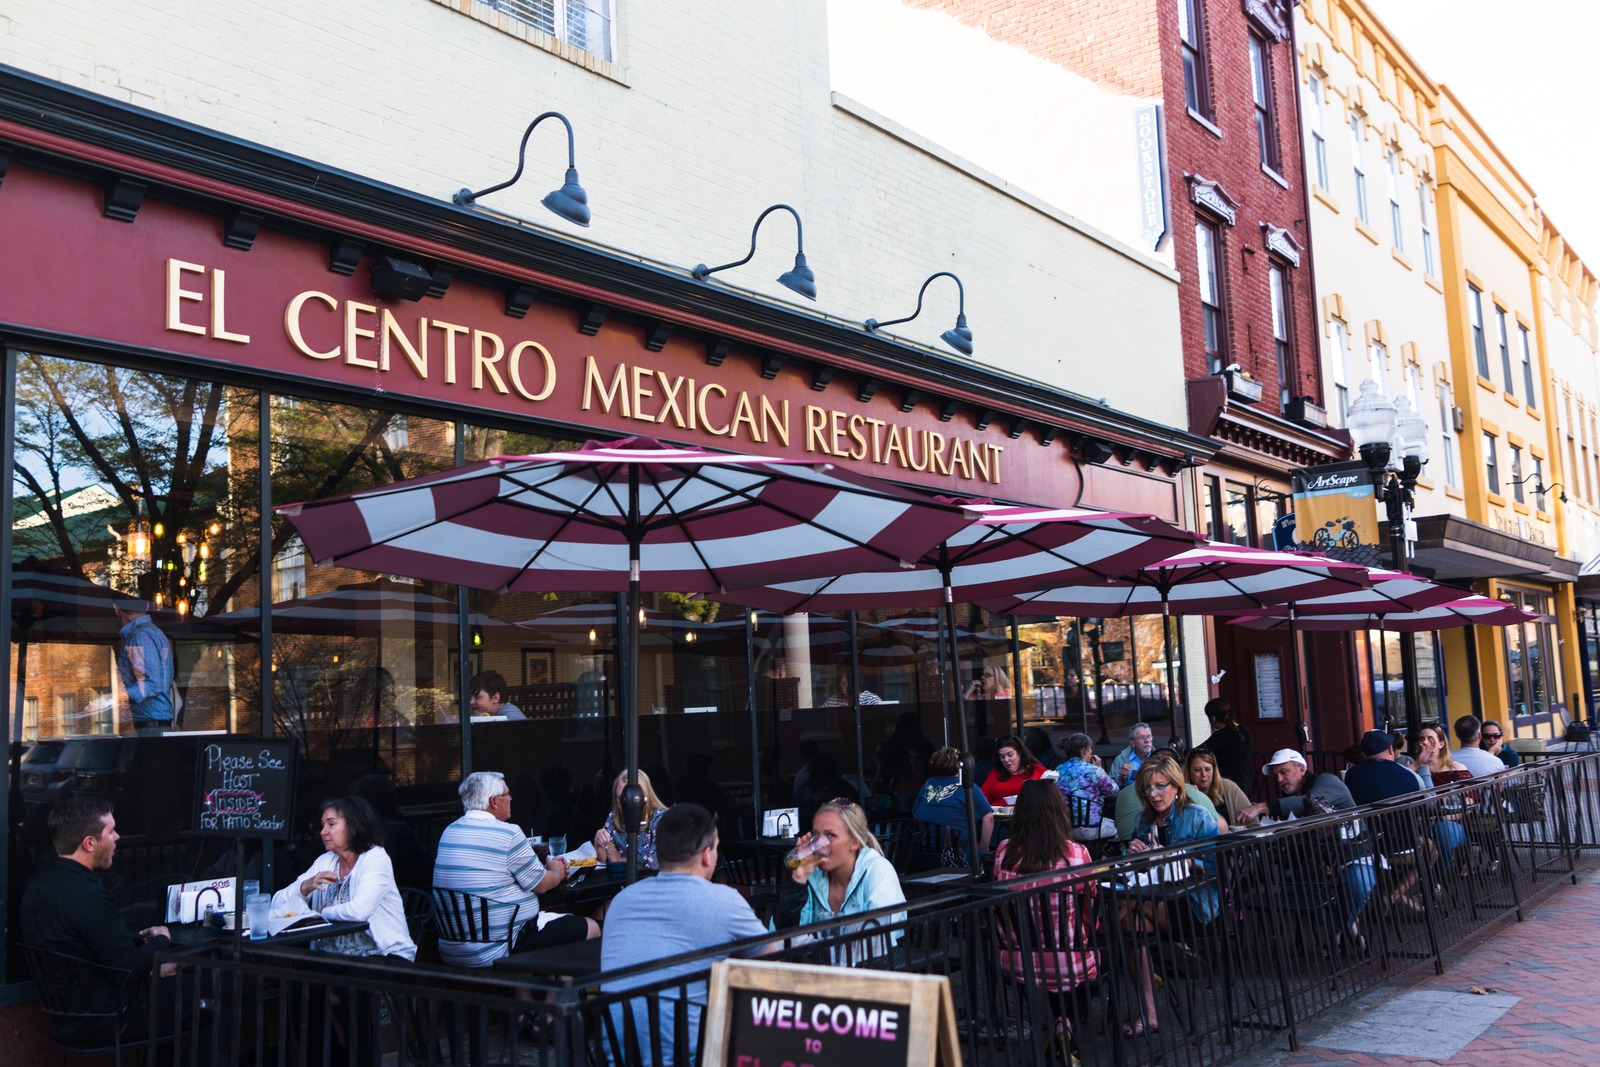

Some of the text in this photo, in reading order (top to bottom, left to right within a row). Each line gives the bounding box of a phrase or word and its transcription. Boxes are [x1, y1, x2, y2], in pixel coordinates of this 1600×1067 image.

[1138, 113, 1157, 227] BOOKSTORE
[165, 258, 1004, 485] EL CENTRO MEXICAN RESTAURANT
[1307, 474, 1358, 490] ArtScape
[204, 744, 286, 772] Please See
[200, 811, 218, 830] FOR
[216, 812, 251, 830] PATIO
[751, 996, 899, 1041] WELCOME
[804, 1038, 822, 1054] TO
